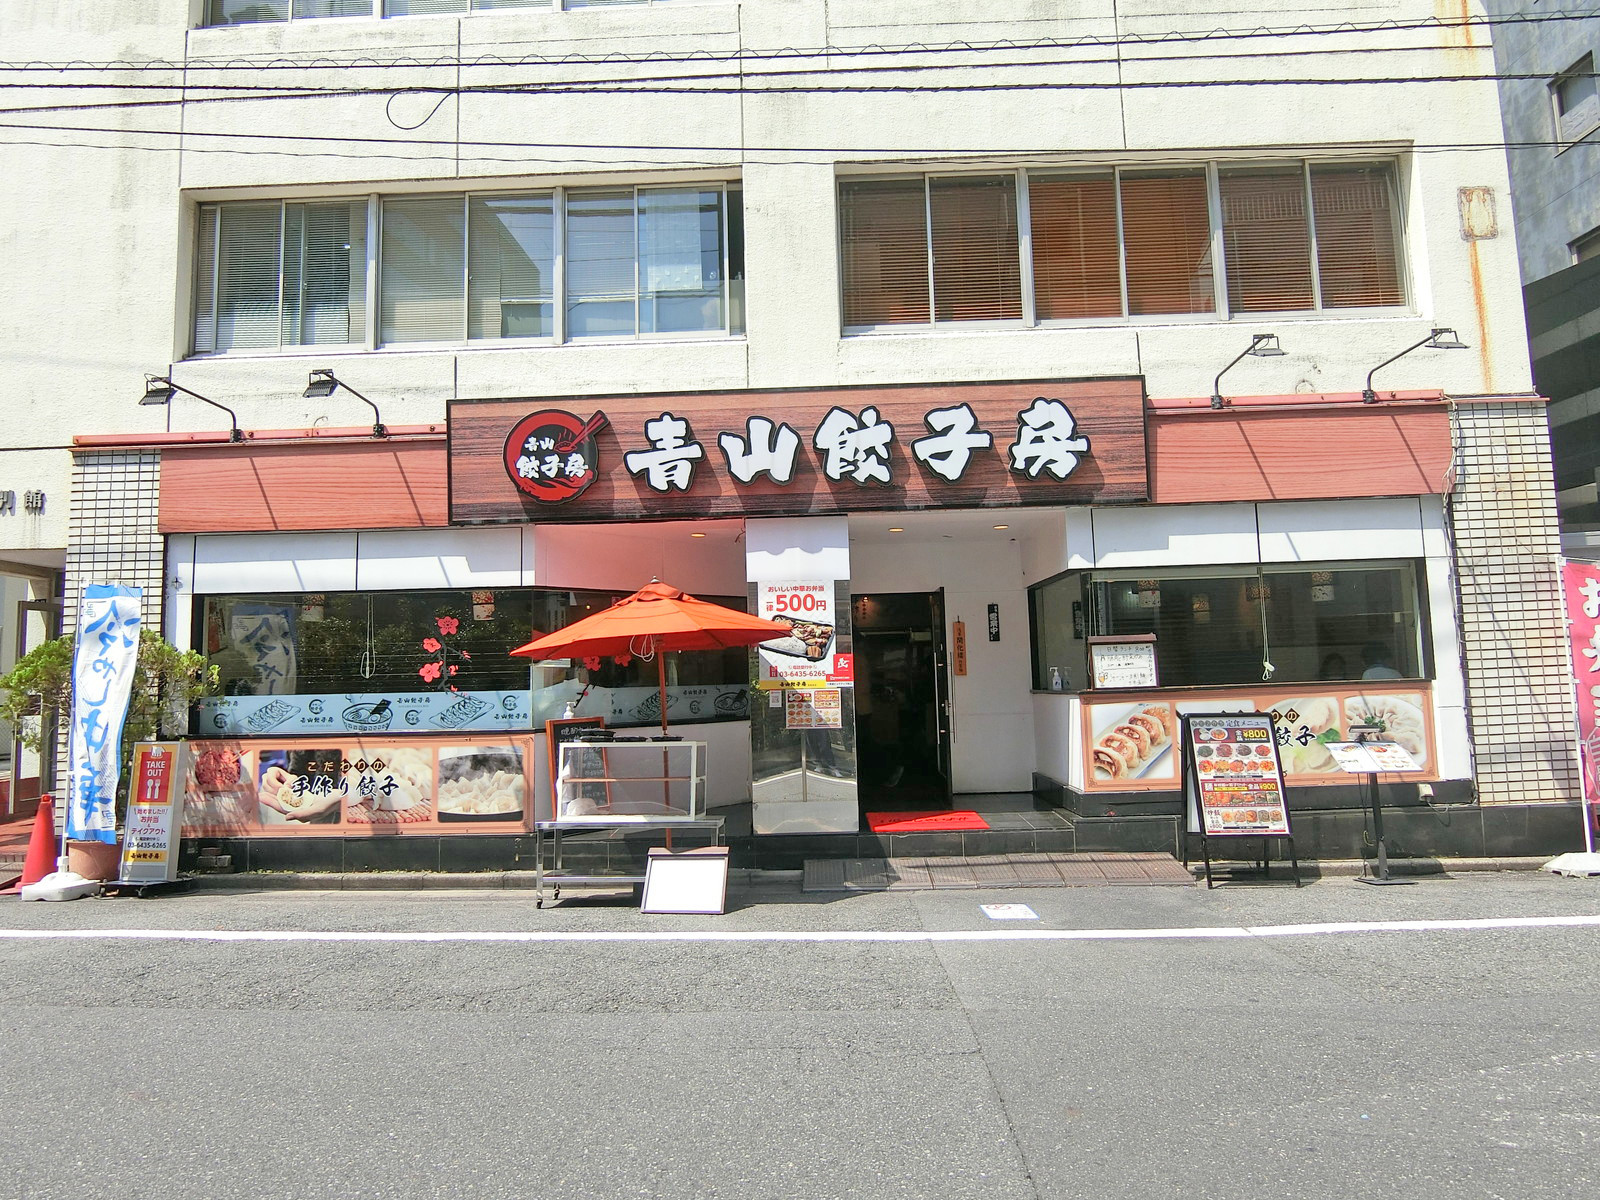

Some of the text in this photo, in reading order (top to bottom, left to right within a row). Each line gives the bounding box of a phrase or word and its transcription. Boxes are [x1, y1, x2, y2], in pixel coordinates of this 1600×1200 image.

[524, 436, 555, 452] 青山
[626, 398, 1090, 493] 青山餃子房
[515, 453, 589, 479] 餃子房
[776, 593, 827, 612] 500円
[1243, 729, 1267, 738] ¥800
[146, 761, 166, 769] TAKE
[147, 769, 163, 777] OUT
[308, 760, 384, 772] こだわりの
[292, 775, 400, 798] 手作り餃子
